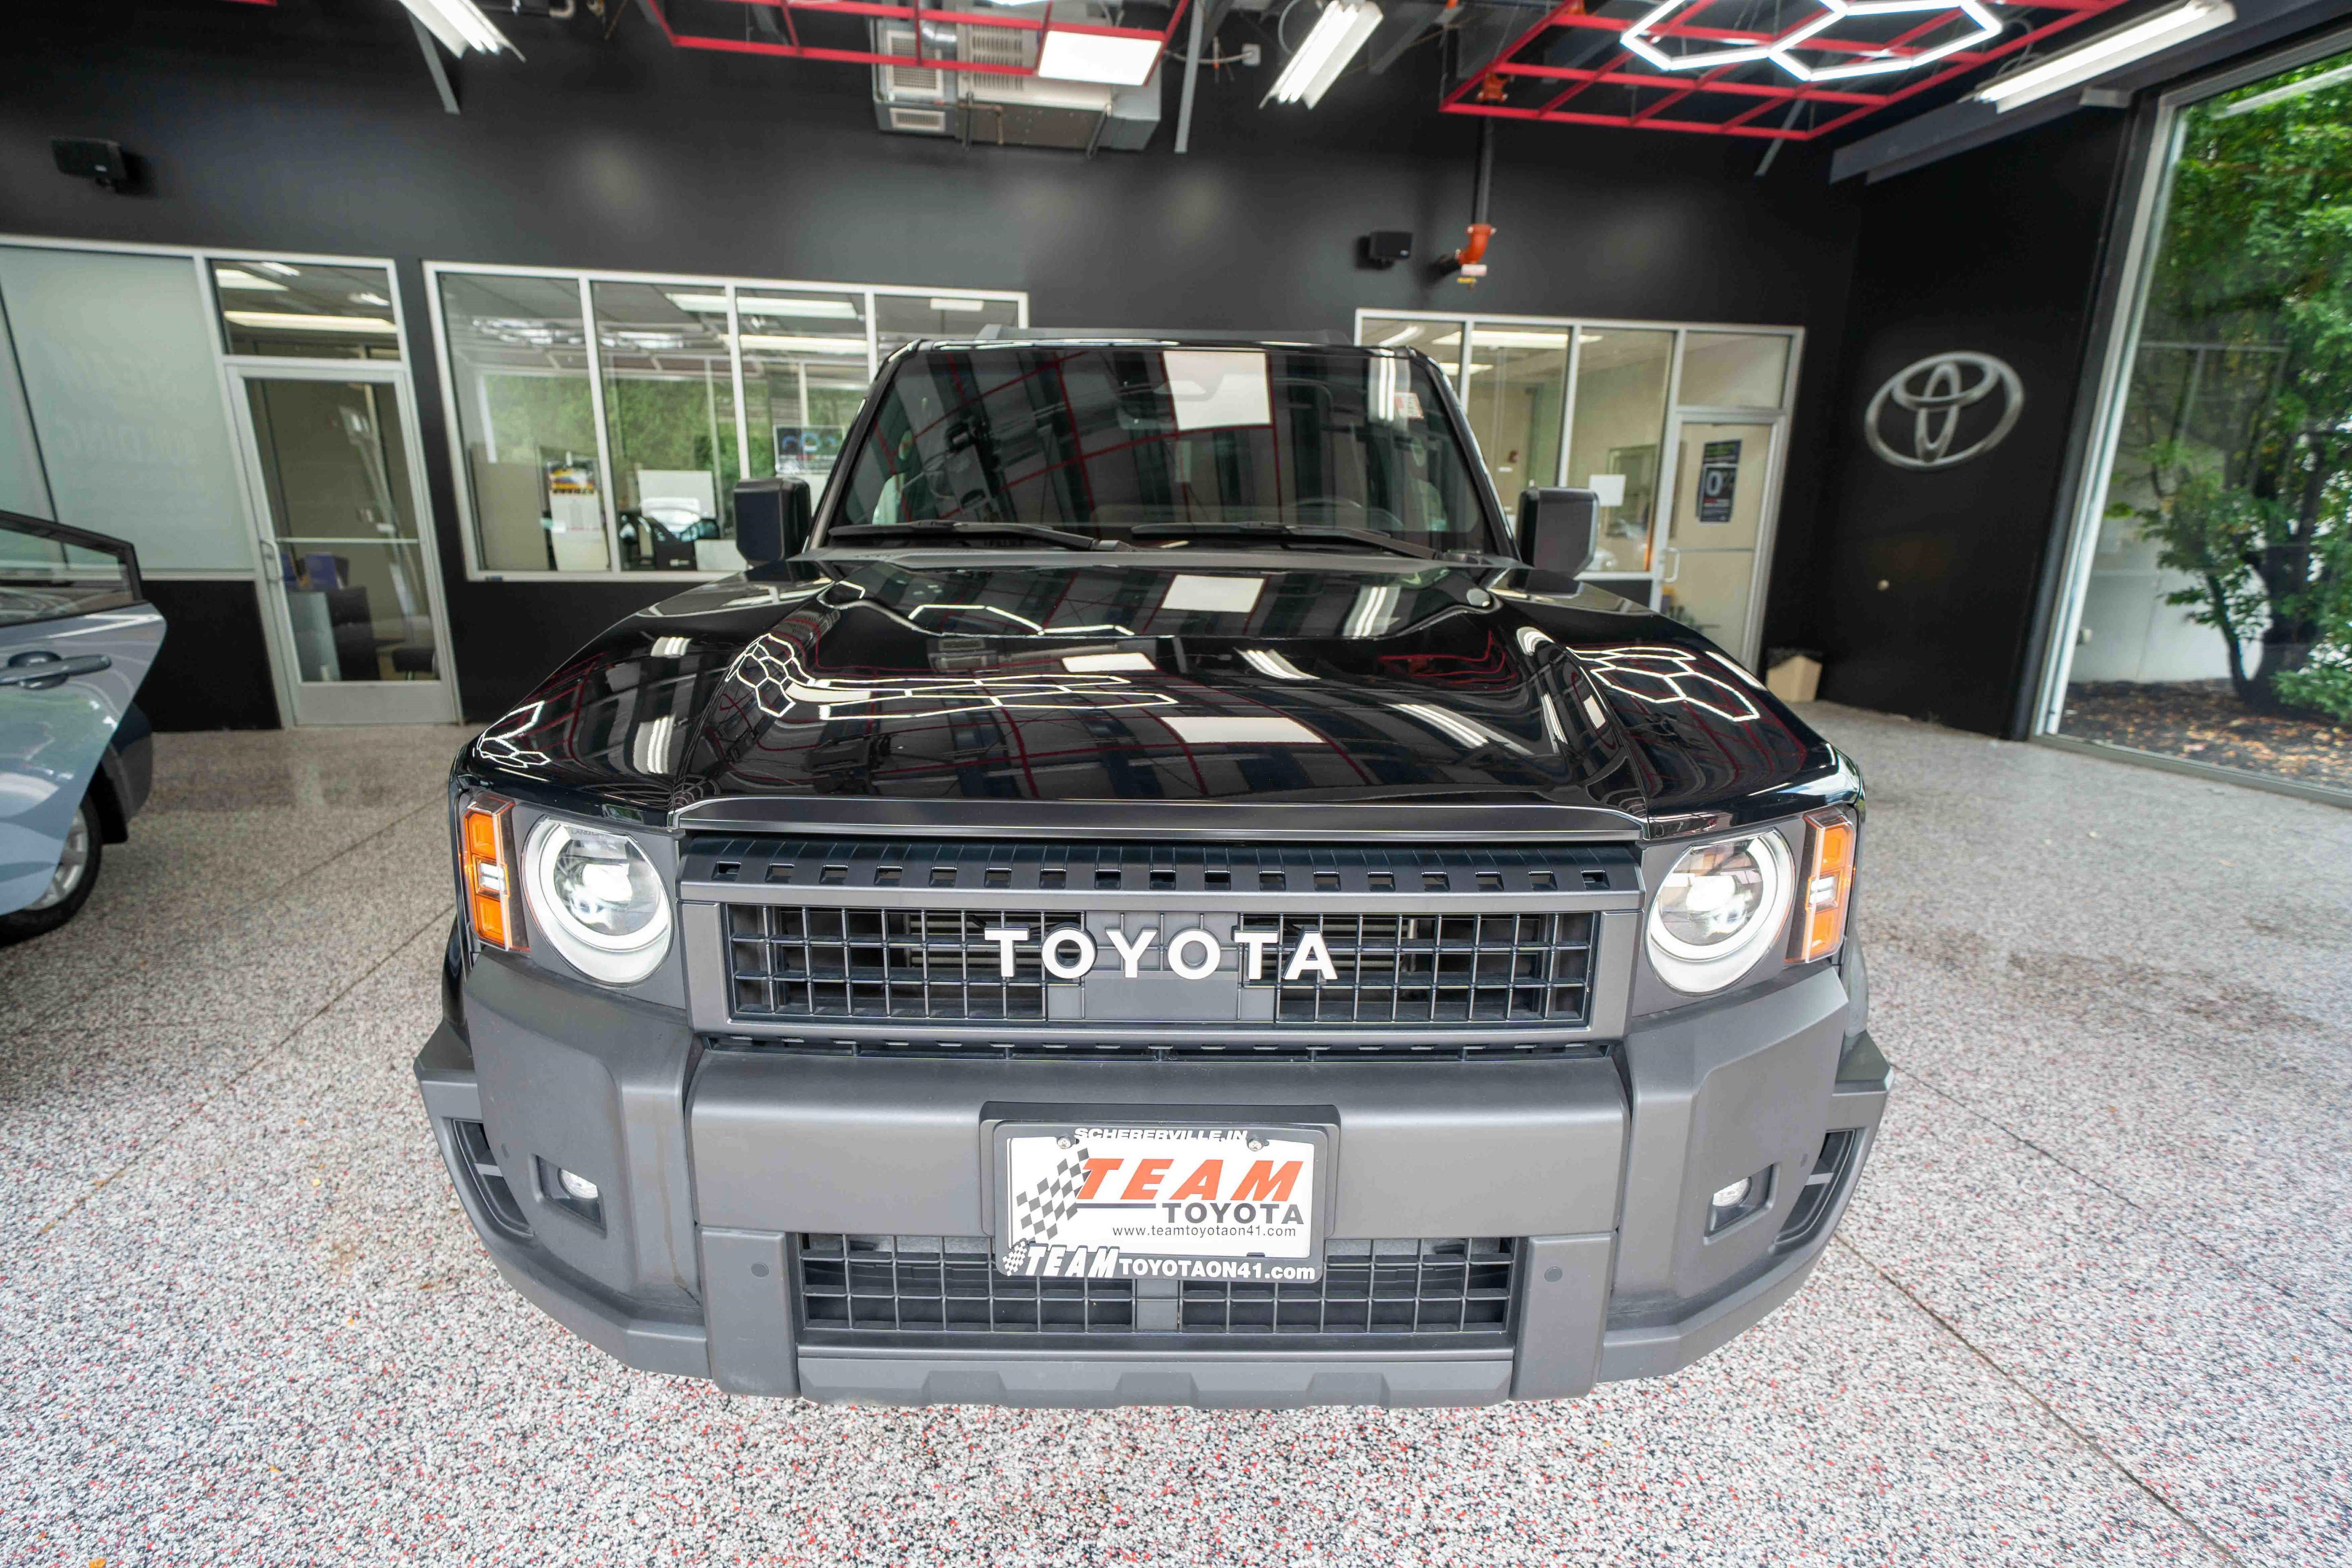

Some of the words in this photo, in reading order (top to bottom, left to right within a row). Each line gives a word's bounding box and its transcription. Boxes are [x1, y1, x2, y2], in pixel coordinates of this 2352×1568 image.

[984, 924, 1338, 980] TOYOTA
[1077, 1158, 1304, 1202] TEAM
[1162, 1202, 1304, 1225] TOYOTA
[1112, 1225, 1296, 1238] www.teamtoyotaon41.com
[1025, 1245, 1120, 1278] TEAM
[1119, 1258, 1315, 1280] TOYOTAON41.com
